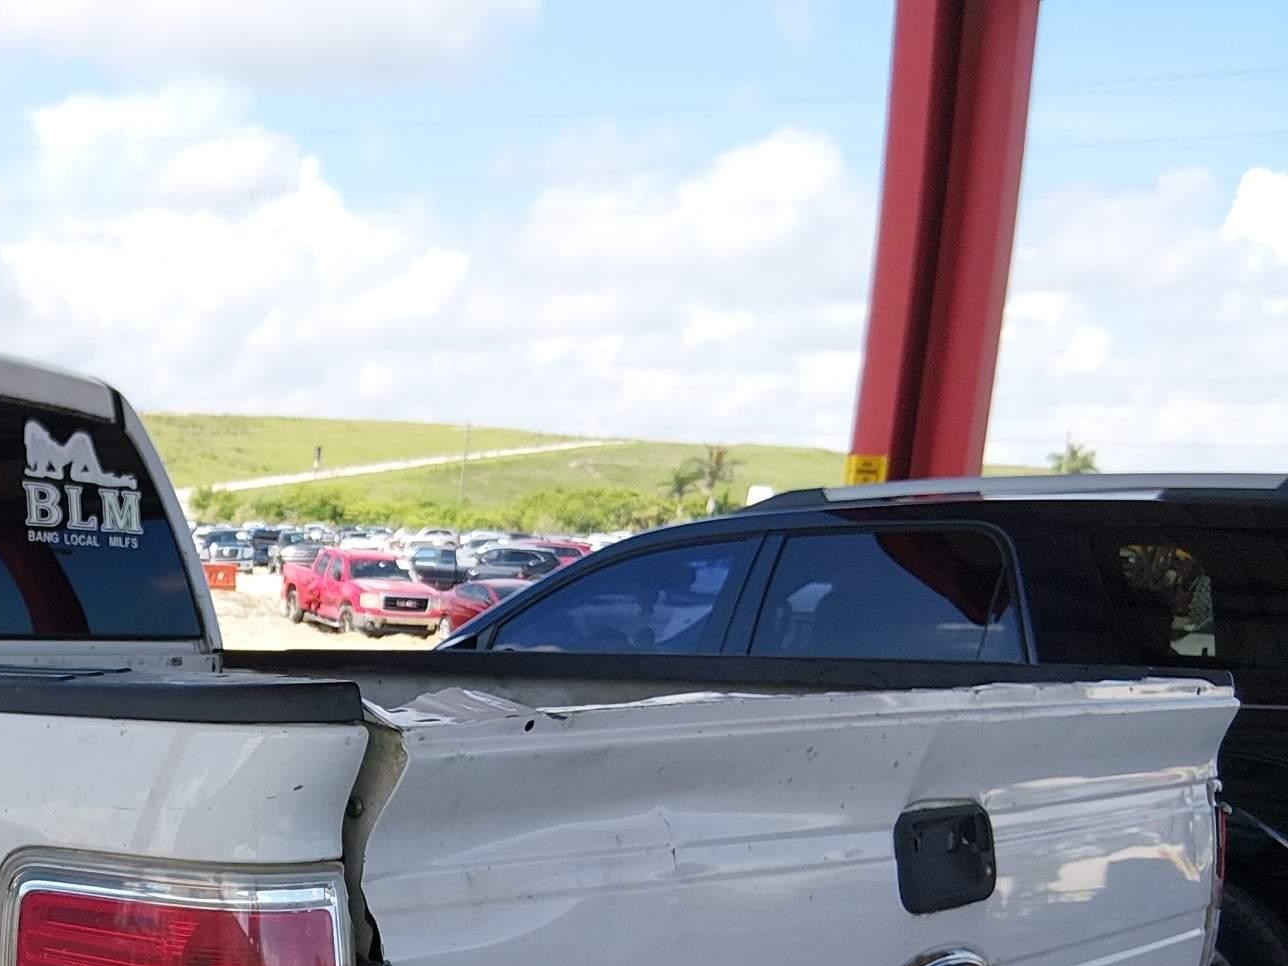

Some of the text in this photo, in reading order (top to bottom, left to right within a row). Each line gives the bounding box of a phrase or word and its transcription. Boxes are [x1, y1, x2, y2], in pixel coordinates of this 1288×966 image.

[22, 481, 144, 535] BLM
[27, 530, 139, 549] BANG LOCAL MILFS
